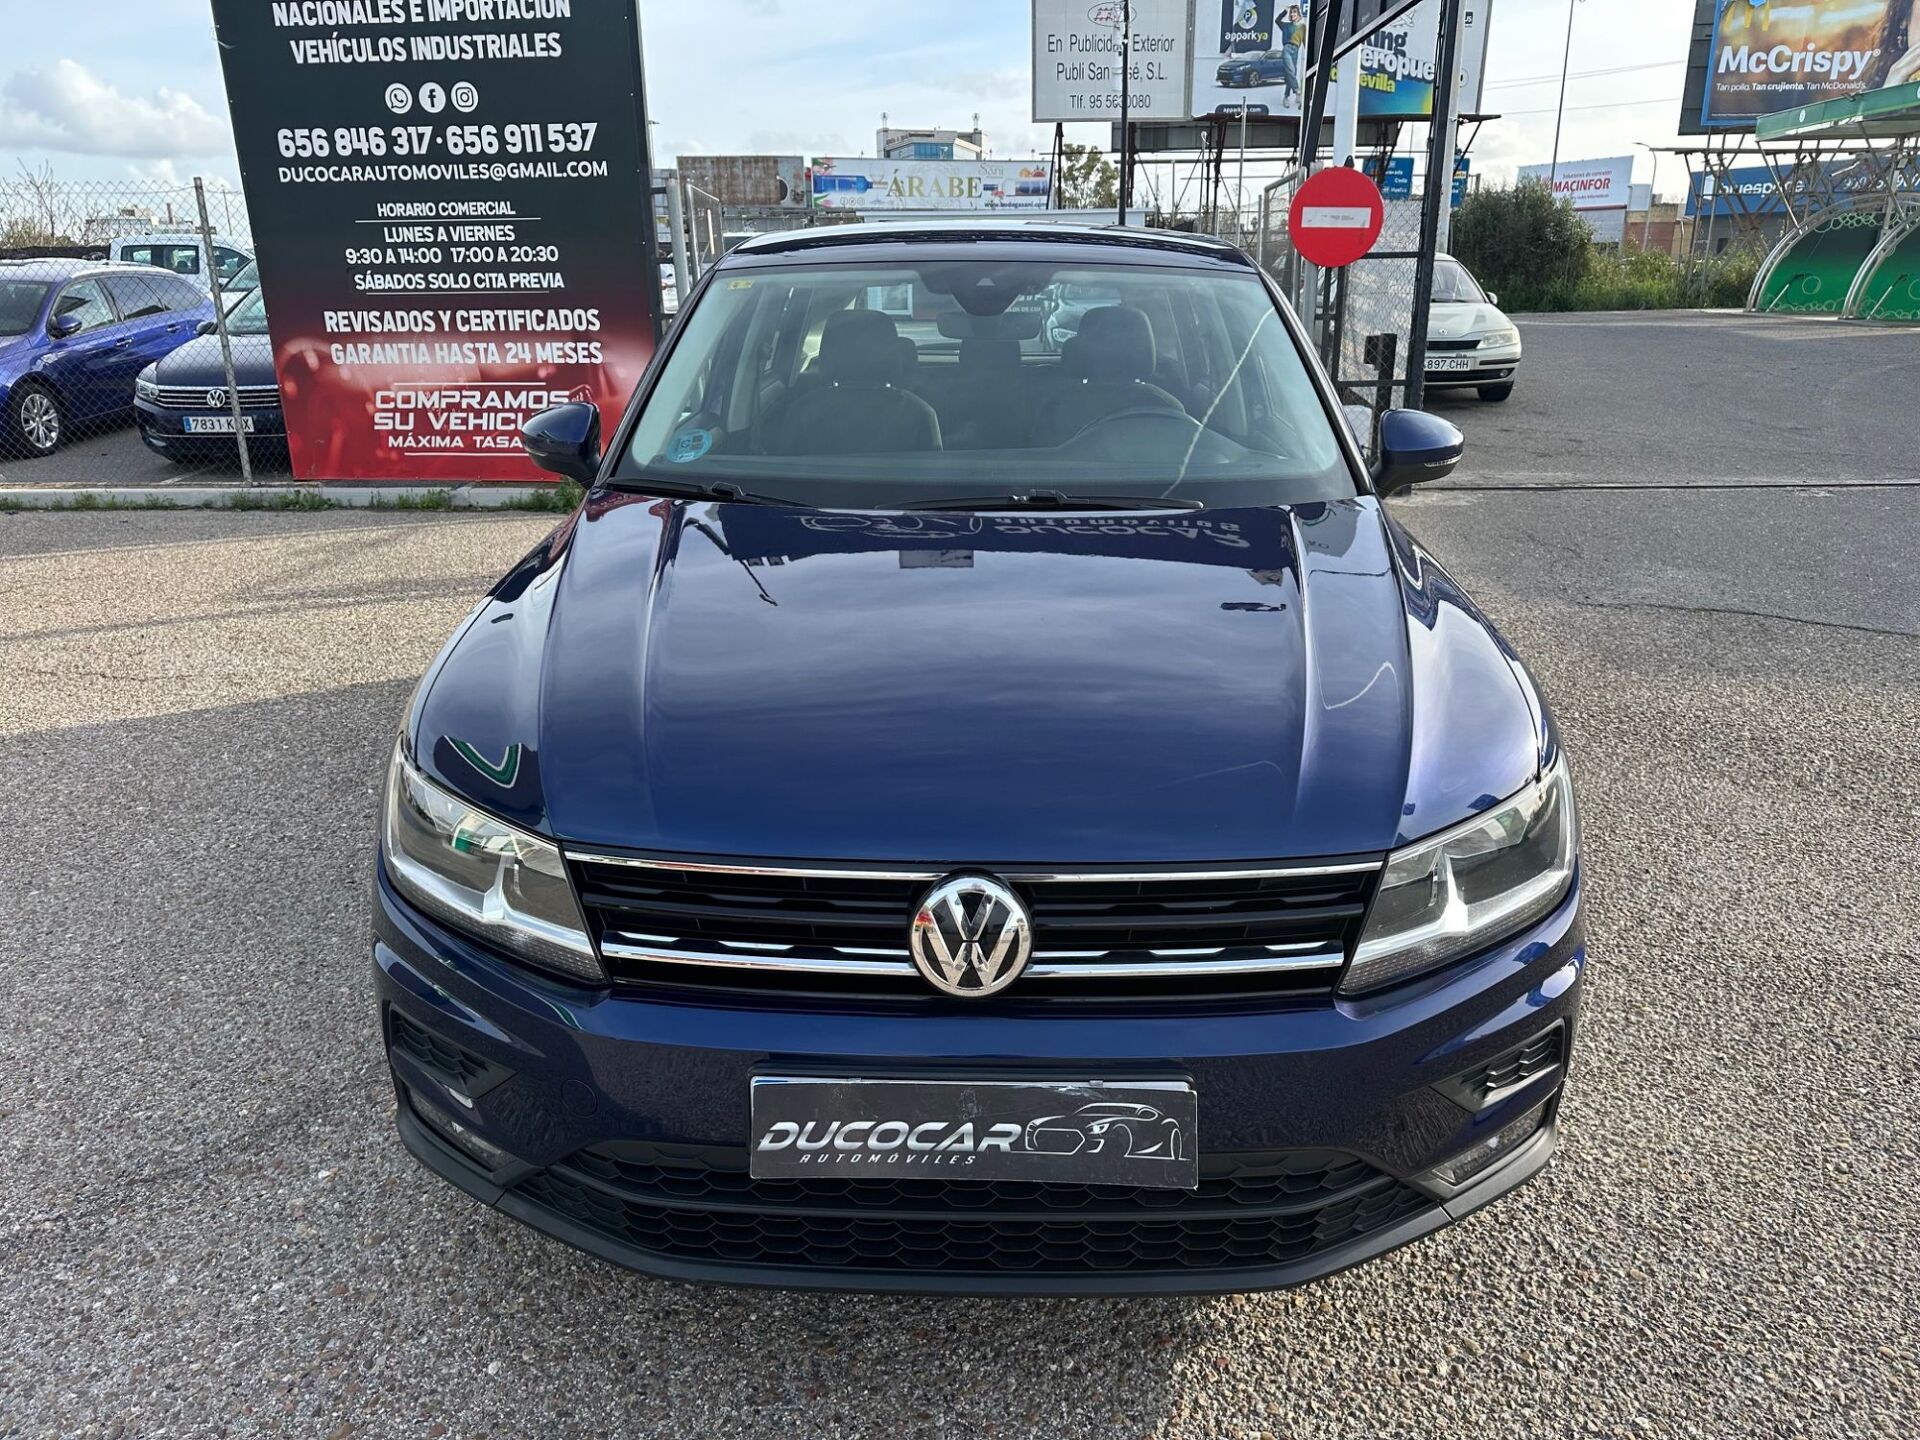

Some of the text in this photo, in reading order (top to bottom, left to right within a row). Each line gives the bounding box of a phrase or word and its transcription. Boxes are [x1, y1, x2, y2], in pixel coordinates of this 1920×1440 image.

[272, 0, 406, 26] NACIONALES
[410, 0, 424, 22] E
[1048, 34, 1175, 52] En Publicid Exterior
[1225, 30, 1268, 42] apparkya
[289, 32, 562, 64] VEHÍCULOS INDUSTRIALES
[1056, 62, 1085, 81] Publi
[1088, 62, 1110, 81] San
[1146, 62, 1168, 80] S.L.
[1361, 49, 1435, 81] eropue
[1360, 73, 1396, 93] evilla
[1716, 82, 1730, 91] Tan
[1752, 82, 1767, 91] Tan
[1768, 81, 1805, 93] crujiente.
[1807, 81, 1820, 90] Tan
[1070, 94, 1086, 109] Tlf.
[1089, 94, 1103, 109] 95
[277, 128, 330, 158] 656
[334, 126, 387, 157] 846
[504, 123, 543, 154] 911
[547, 122, 598, 153] 537
[278, 160, 608, 183] DUCOCARAUTOMOVILES@GMAIL.COM
[887, 169, 982, 199] ÁRABE
[377, 201, 516, 217] HORARIO COMERCIAL
[384, 225, 515, 242] LUNES A VIERNES
[345, 245, 558, 264] 9:30 A 14:00 17:00 A 20:30
[354, 270, 564, 290] SÁBADOS SOLO CITA PREVIA
[324, 309, 601, 332] REVISADOS Y CERTIFICADOS
[331, 342, 603, 364] GARANTIA HASTA 24 MESES
[1424, 360, 1469, 369] 897 CHH
[375, 390, 570, 409] COMPRAMOS
[192, 418, 251, 430] 7831 KX
[374, 412, 524, 431] SU VEHIC
[388, 433, 523, 448] MÁXIMA TASA
[756, 1120, 1023, 1152] DUCOCAR
[800, 1152, 977, 1165] AUTOMÓVILES
